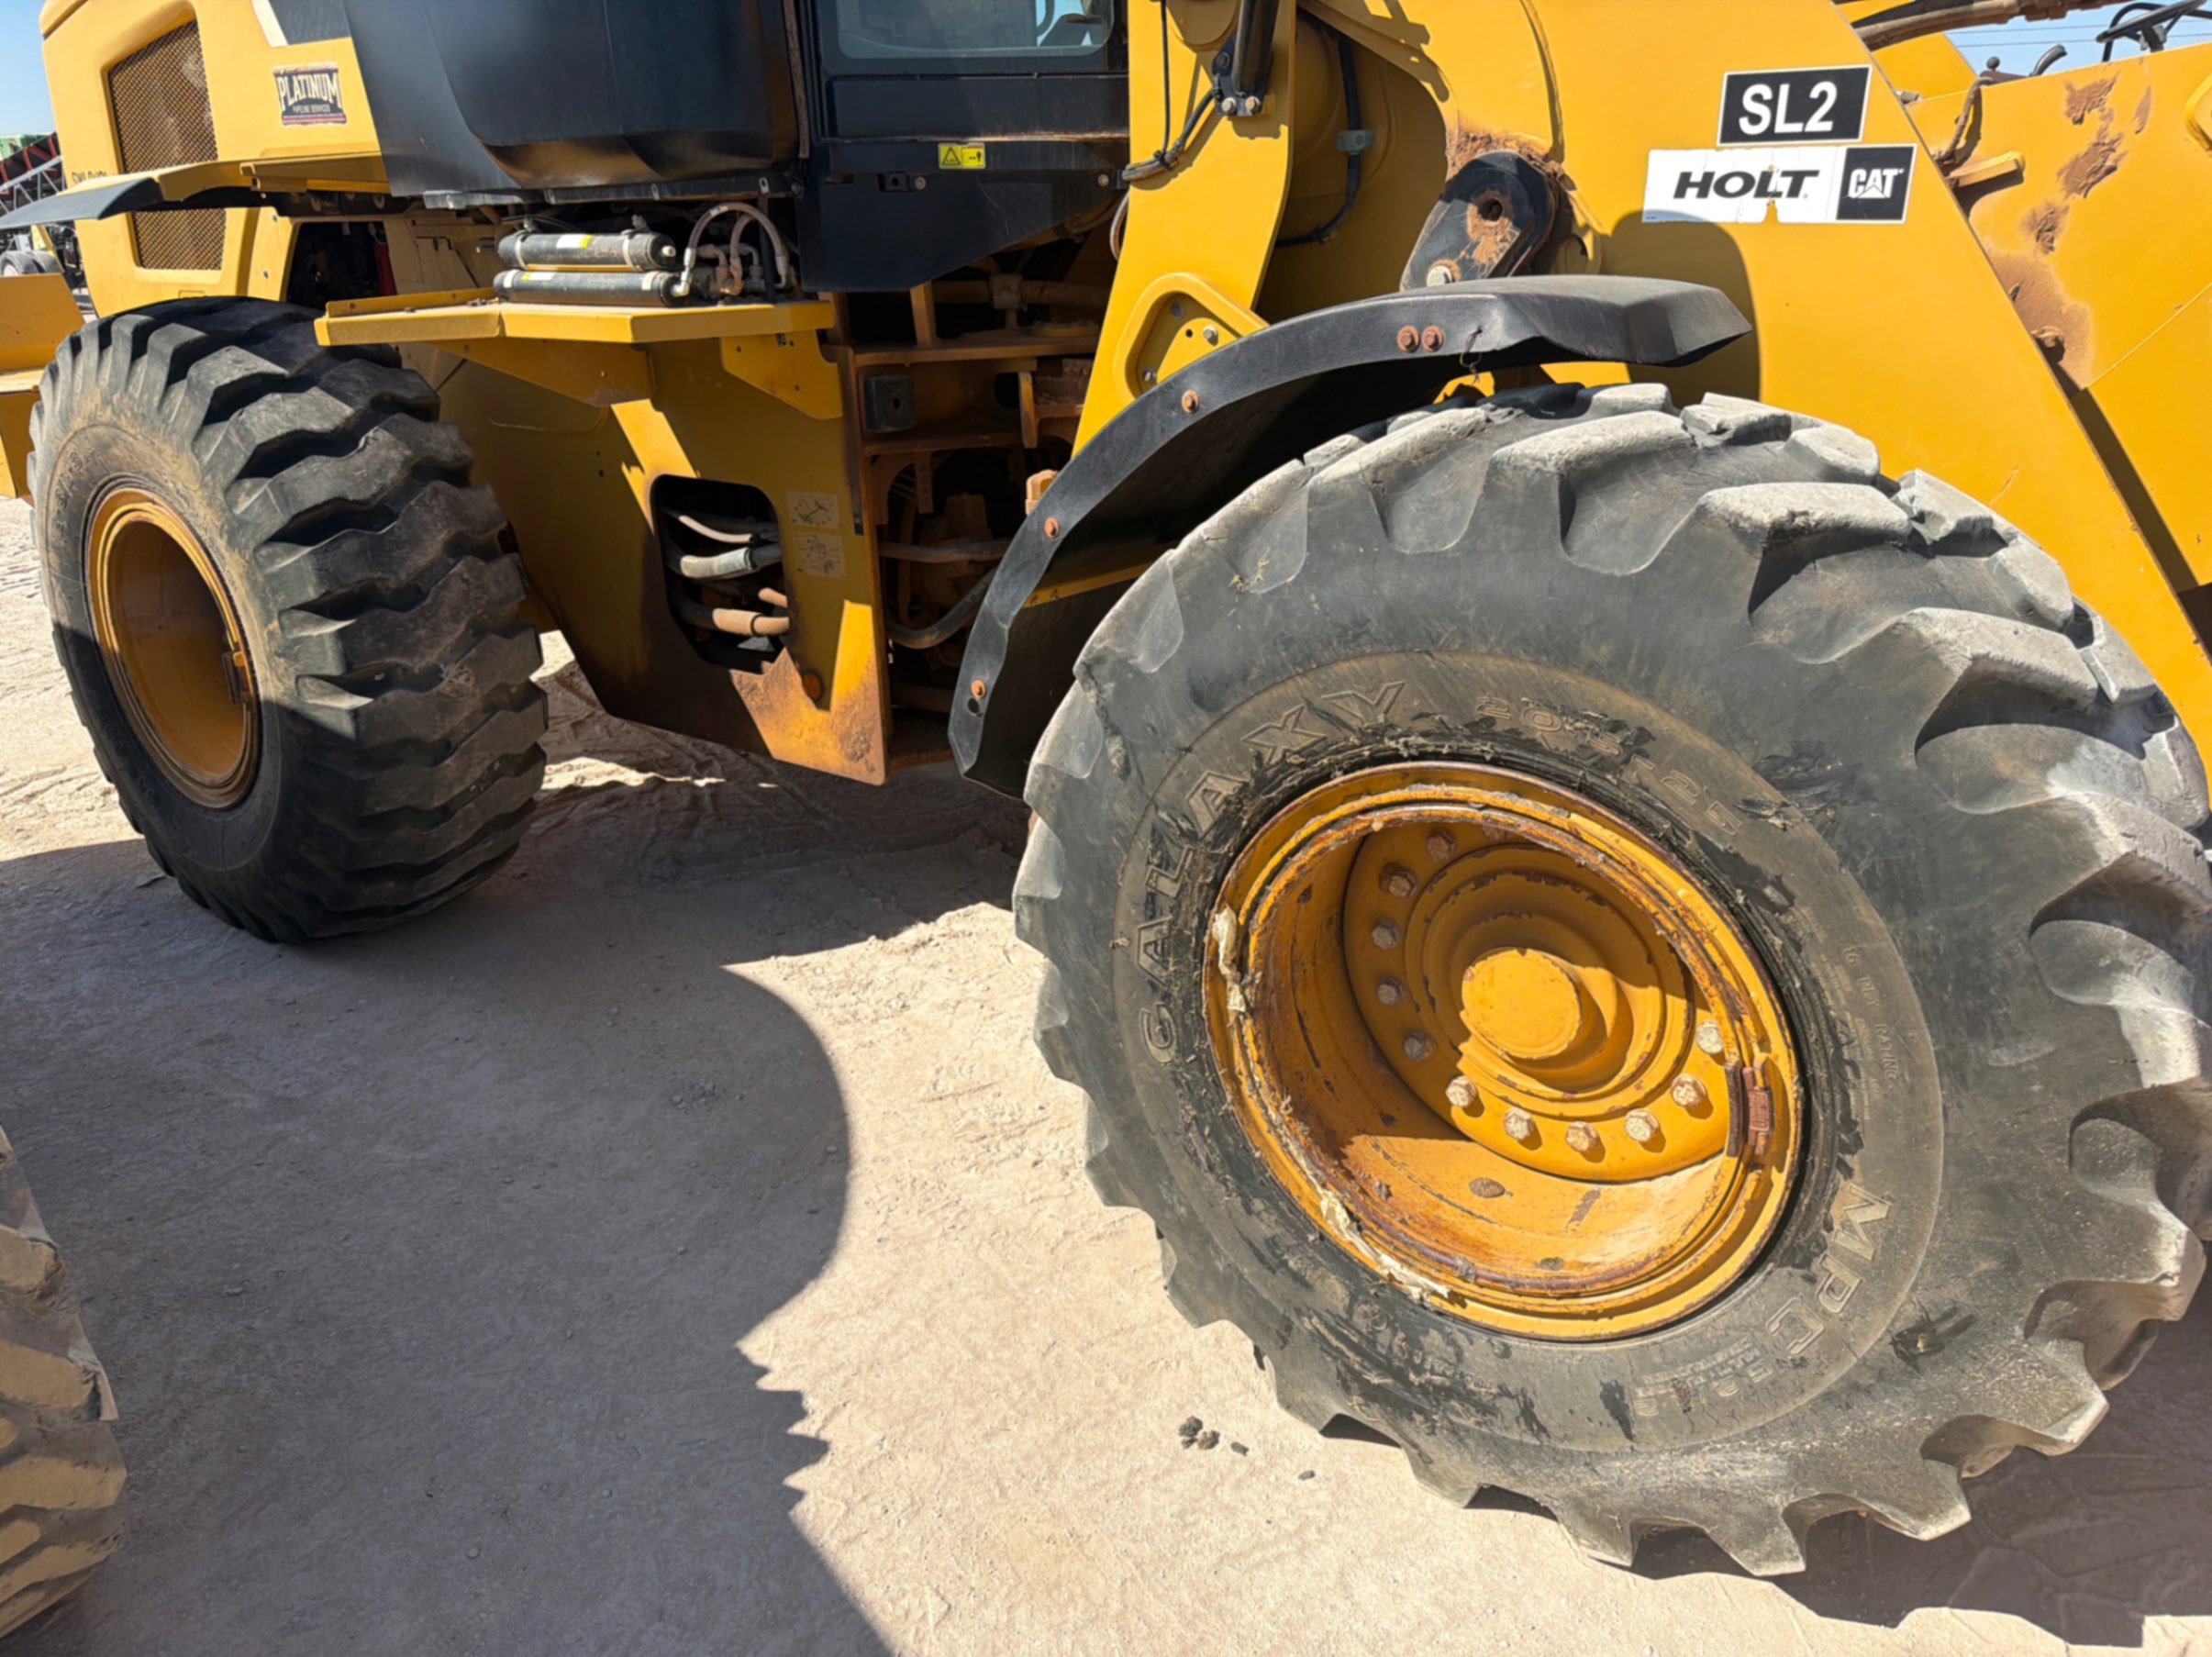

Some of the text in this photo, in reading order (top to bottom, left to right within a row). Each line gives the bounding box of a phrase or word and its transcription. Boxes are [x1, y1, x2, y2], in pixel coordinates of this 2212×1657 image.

[276, 72, 342, 111] PLATINUM
[1739, 81, 1838, 135] SL2
[1673, 168, 1904, 199] HOLT CAT
[1137, 681, 1406, 1062] GALAXY
[1766, 1183, 1894, 1356] MPC
